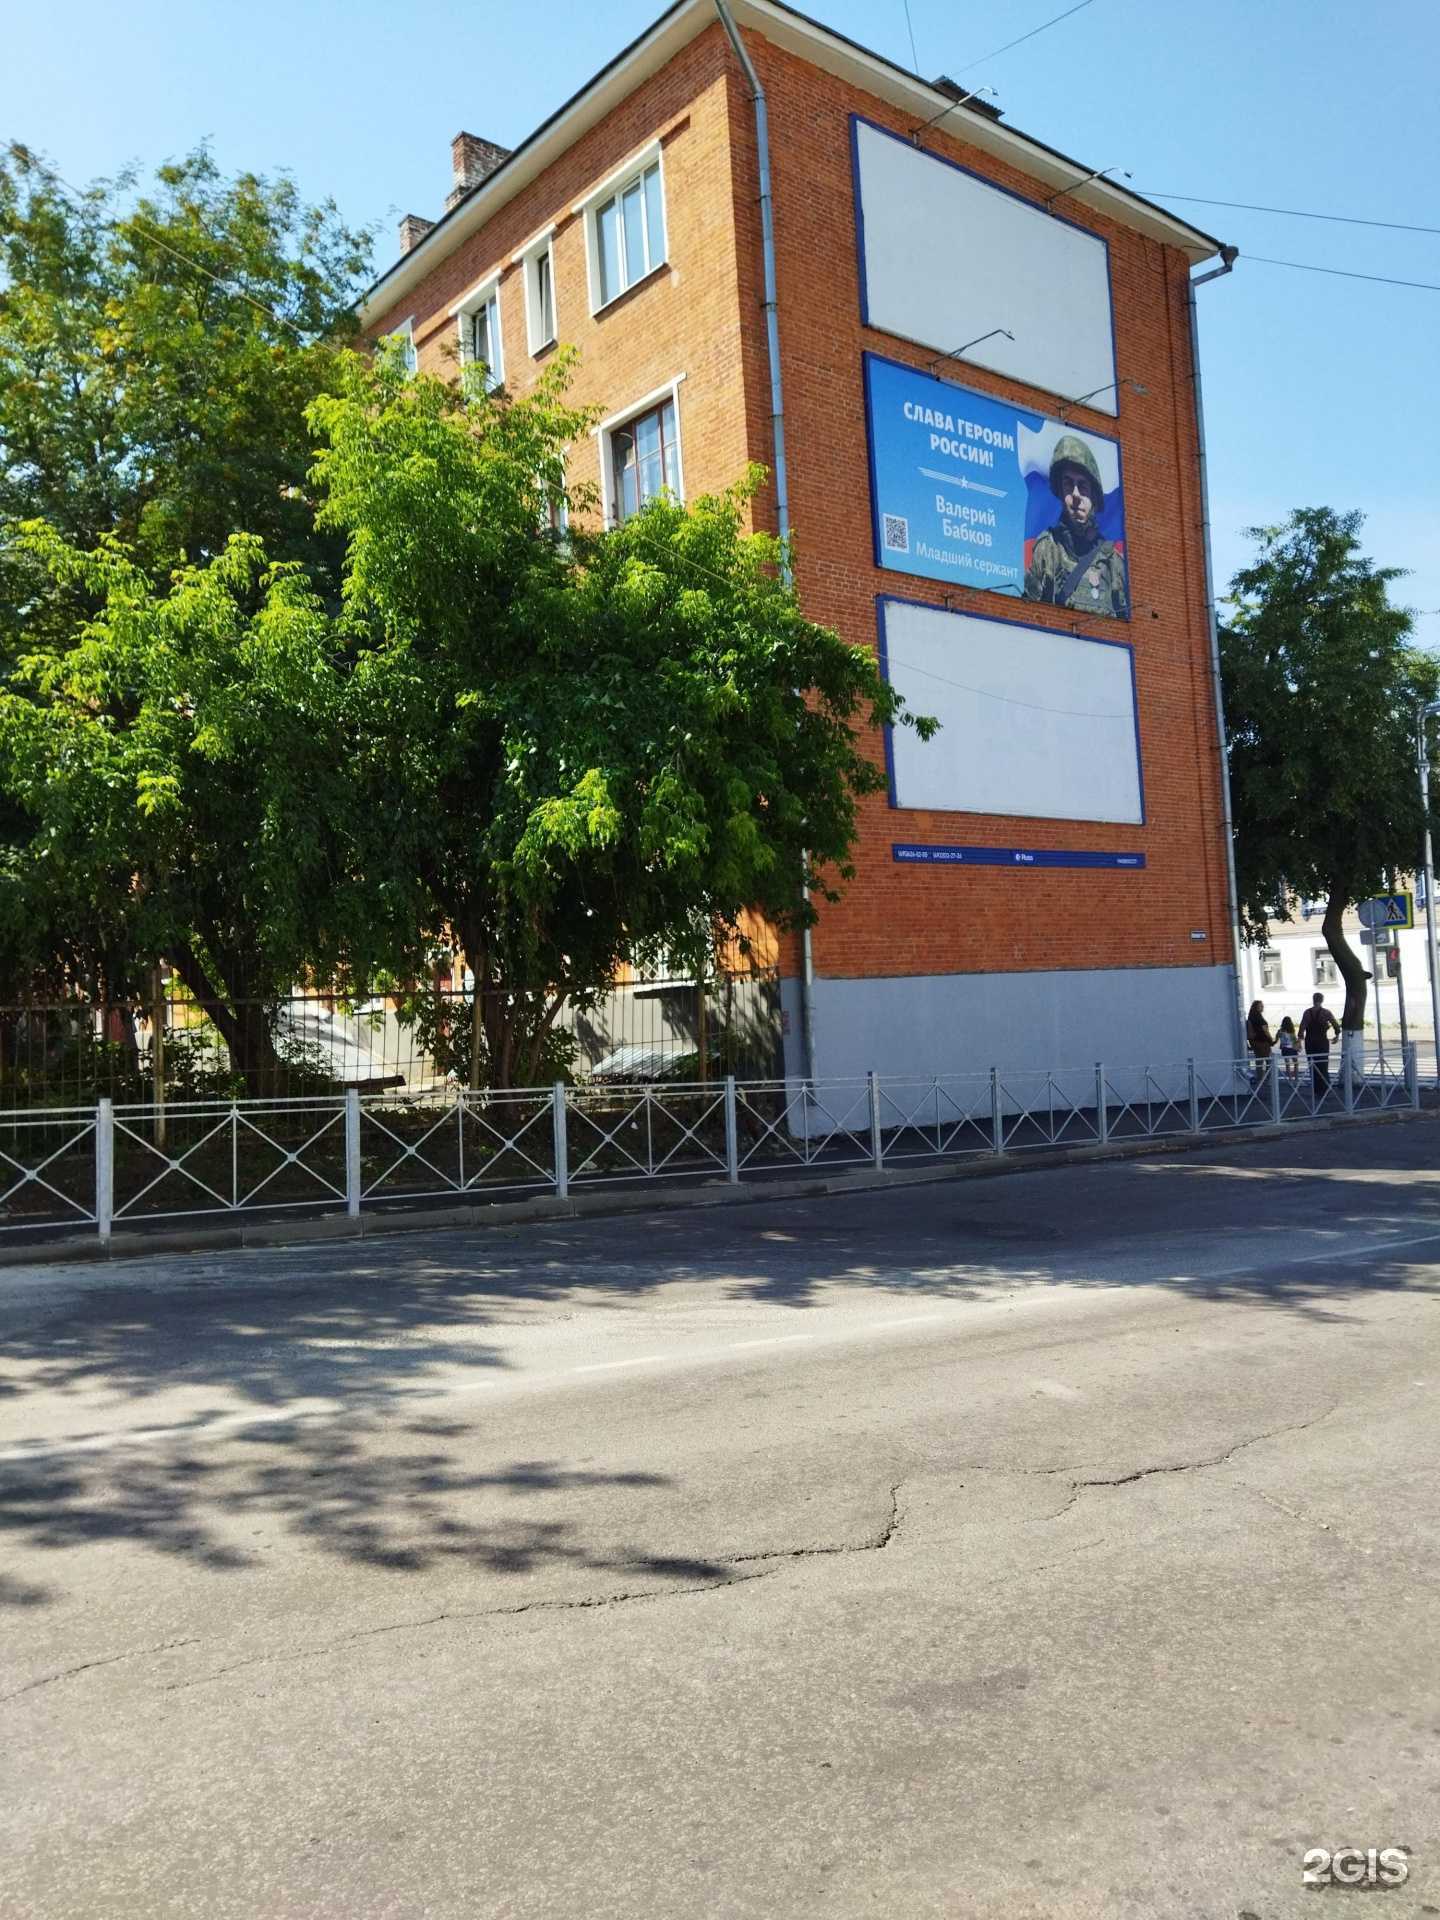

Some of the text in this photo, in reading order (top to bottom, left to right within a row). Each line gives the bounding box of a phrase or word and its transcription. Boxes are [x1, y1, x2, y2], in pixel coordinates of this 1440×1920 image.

[904, 401, 1014, 451] СЛАВА ГЕРОЯМ
[930, 434, 994, 468] РОССИИ!
[936, 494, 995, 526] Валерий
[942, 518, 992, 547] Бабков
[916, 541, 1018, 578] Младший сержант
